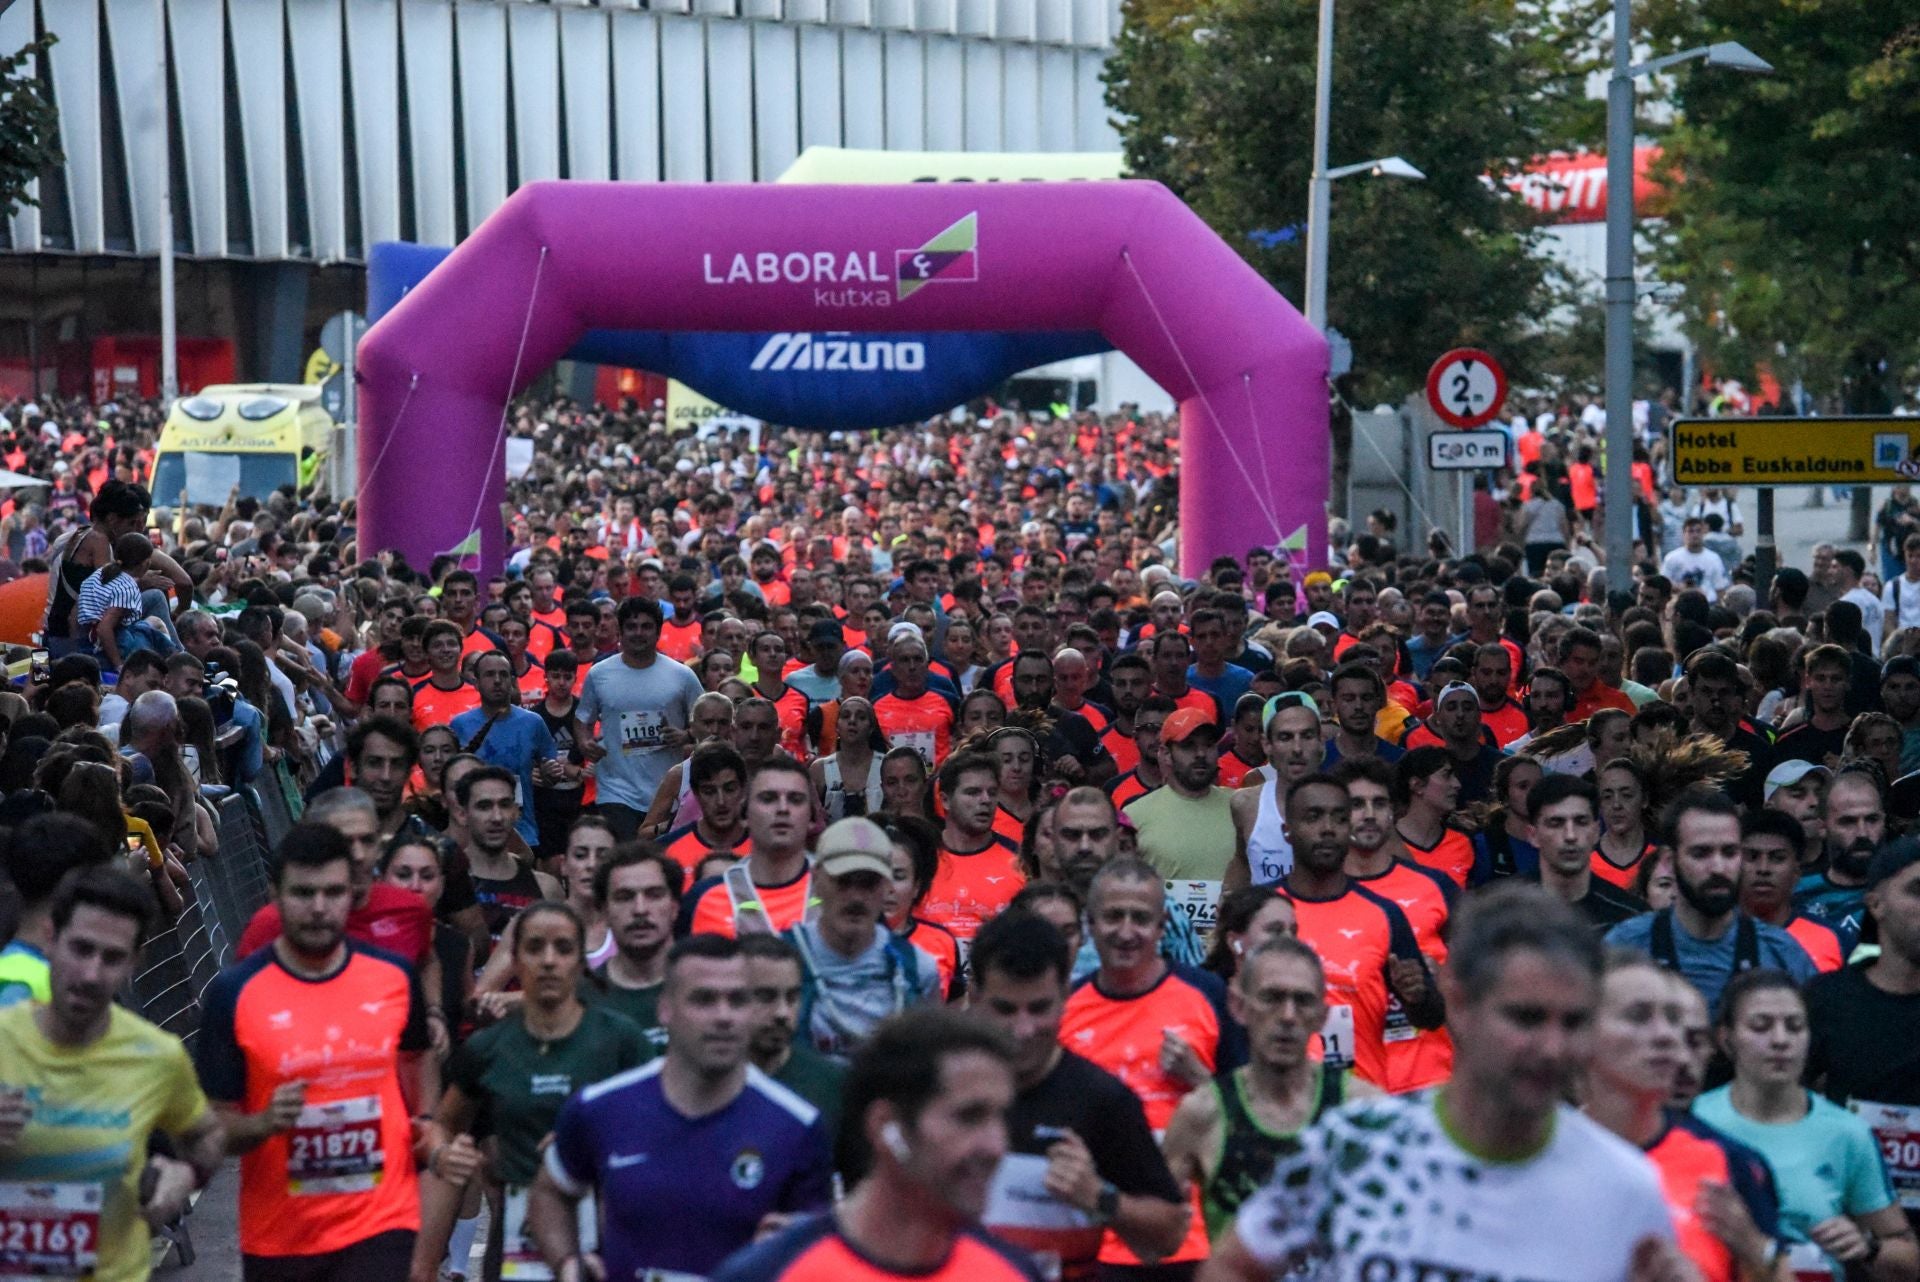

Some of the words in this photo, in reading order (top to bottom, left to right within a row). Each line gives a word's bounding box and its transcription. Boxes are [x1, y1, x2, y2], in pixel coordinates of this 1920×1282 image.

[703, 251, 890, 283] LABORAL
[813, 286, 892, 307] kutxa
[1453, 375, 1469, 402] 2
[1678, 431, 1737, 448] Hotel
[1483, 446, 1499, 456] m
[1679, 457, 1733, 474] Abba
[1743, 456, 1865, 474] Euskalduna
[291, 1128, 377, 1160] 21879
